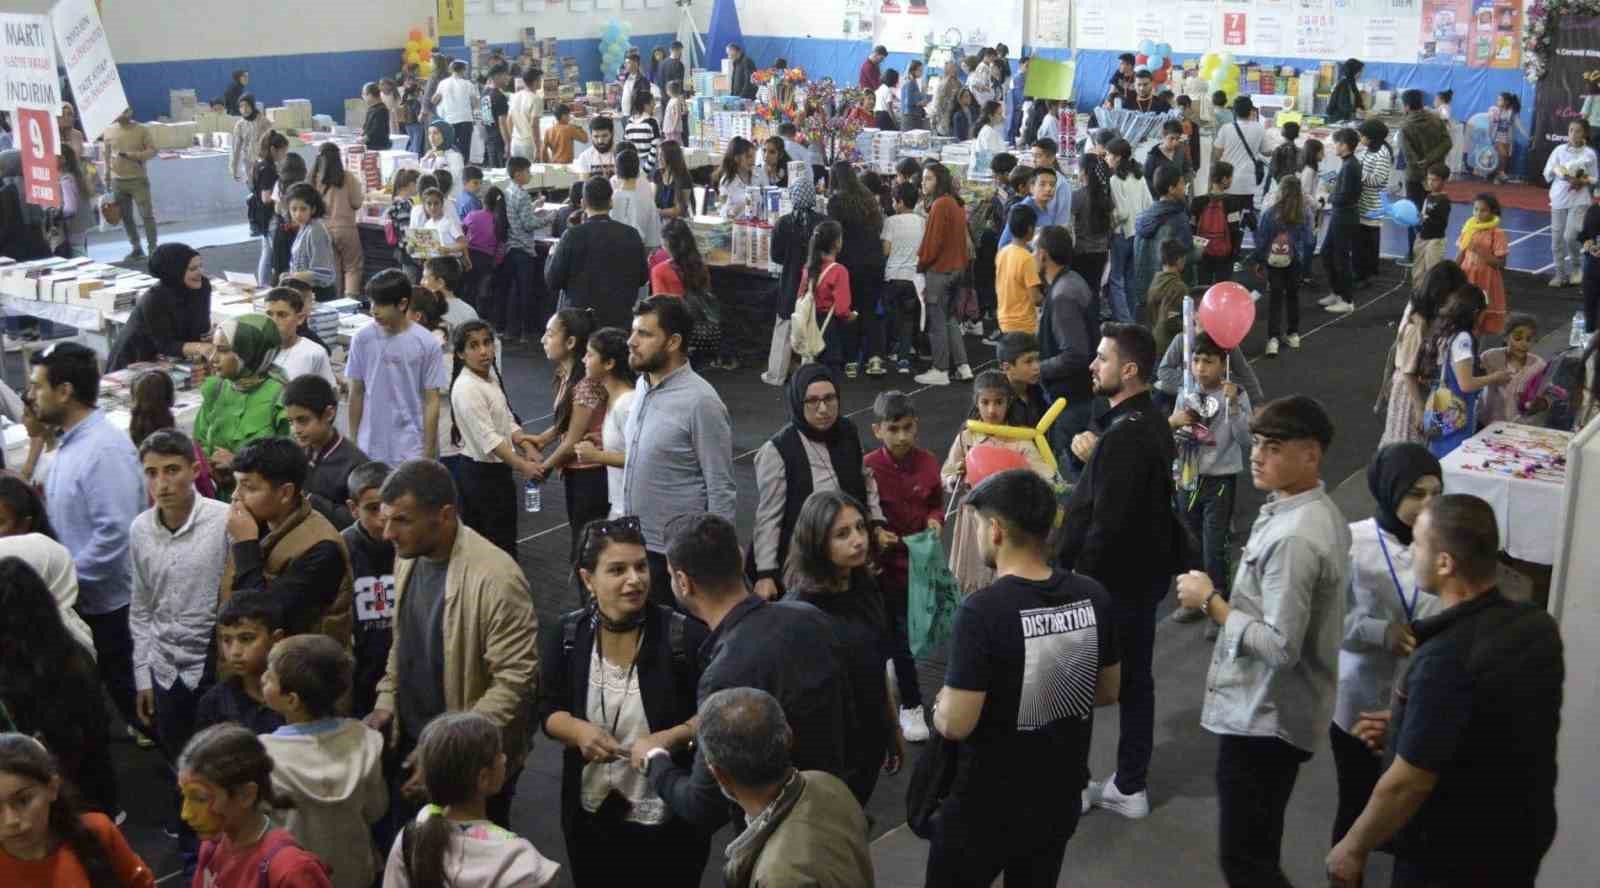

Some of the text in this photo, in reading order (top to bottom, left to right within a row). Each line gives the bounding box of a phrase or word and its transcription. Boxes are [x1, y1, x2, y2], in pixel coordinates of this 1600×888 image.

[1231, 14, 1239, 30] 7
[29, 118, 45, 159] 9
[1021, 605, 1097, 638] DISTORTION
